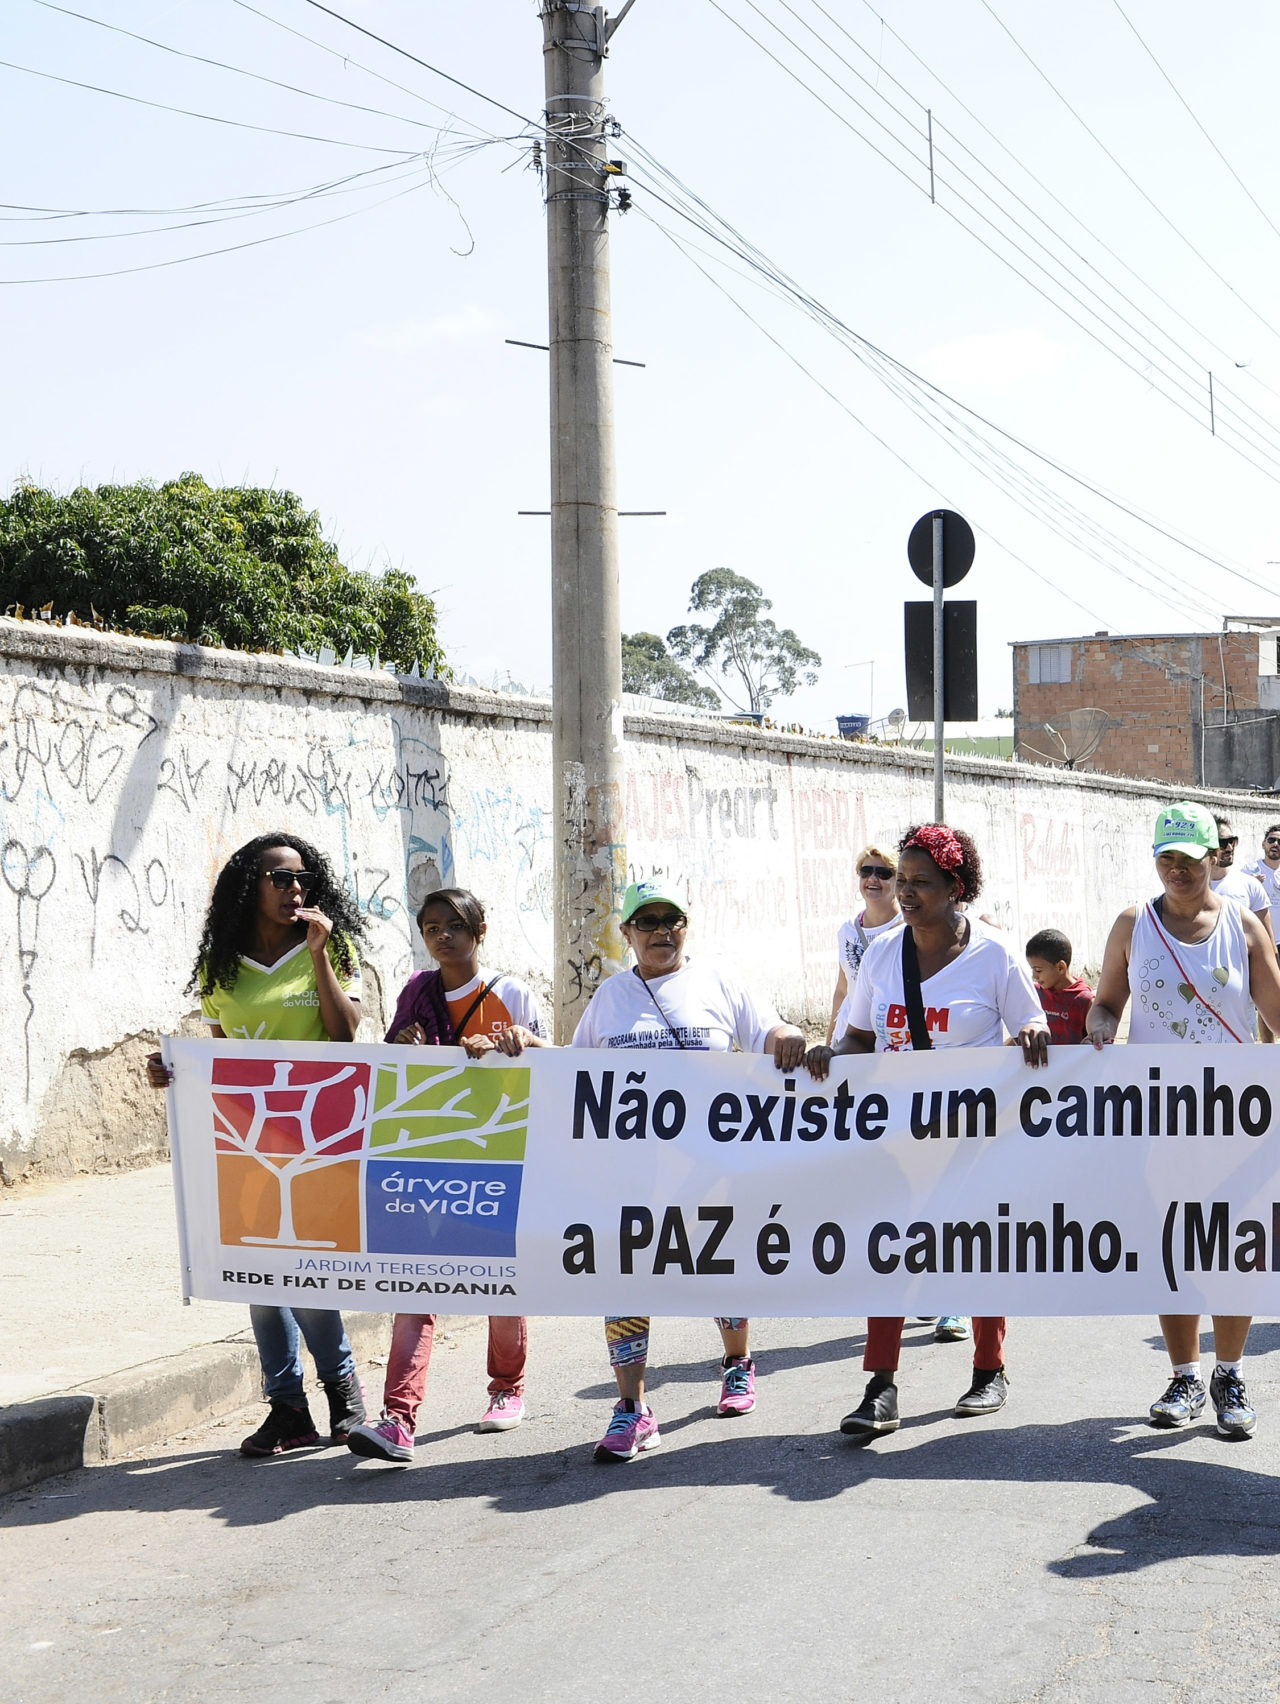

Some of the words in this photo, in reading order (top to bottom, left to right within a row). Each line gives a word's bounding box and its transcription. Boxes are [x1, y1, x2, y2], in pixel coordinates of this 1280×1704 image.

[638, 1030, 653, 1042] VIVA
[654, 1029, 660, 1040] O
[658, 1039, 674, 1048] pela
[572, 1070, 687, 1142] Não
[707, 1078, 890, 1143] existe
[910, 1087, 997, 1140] um
[1019, 1066, 1272, 1138] caminho
[381, 1171, 507, 1197] árvore
[384, 1198, 415, 1214] da
[418, 1196, 499, 1216] vida
[562, 1223, 597, 1275] a
[619, 1205, 735, 1275] PAZ
[756, 1204, 791, 1276] é
[812, 1221, 846, 1275] o
[867, 1202, 1138, 1275] caminho.
[295, 1258, 372, 1273] JARDIM
[376, 1262, 517, 1278] TERESÓPOLIS
[222, 1270, 275, 1286] REDE
[283, 1275, 330, 1289] FIAT
[337, 1278, 366, 1291] DE
[374, 1280, 518, 1296] CIDADANIA
